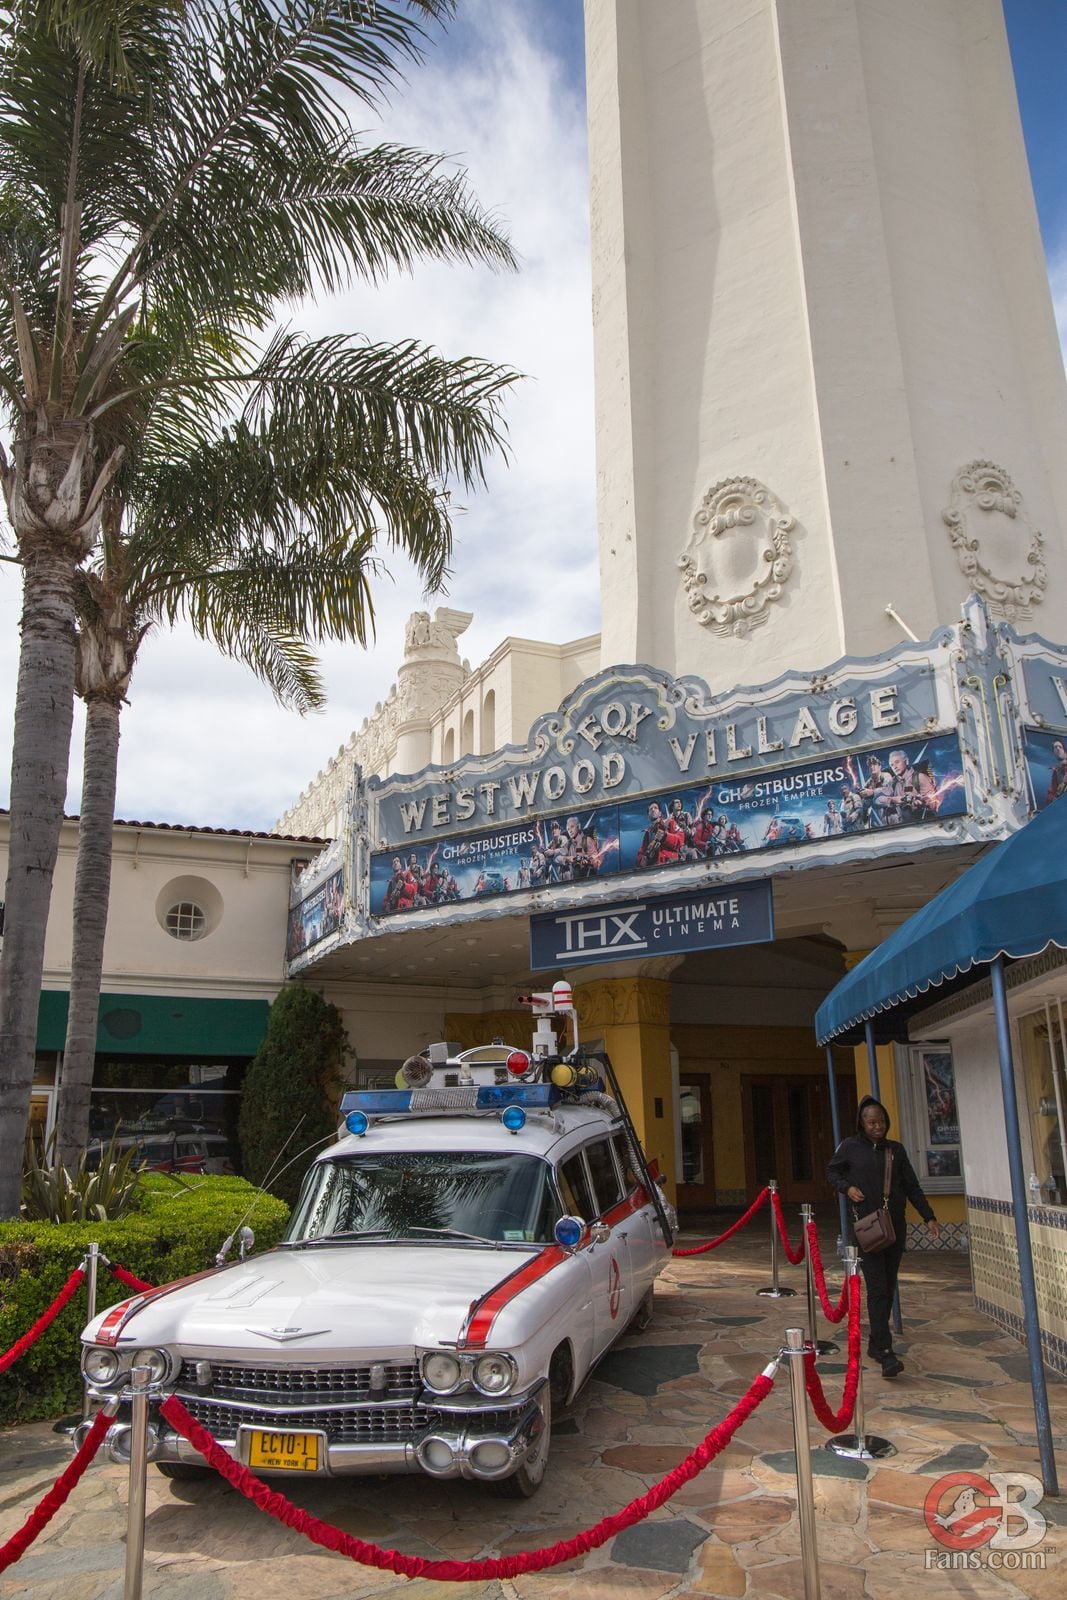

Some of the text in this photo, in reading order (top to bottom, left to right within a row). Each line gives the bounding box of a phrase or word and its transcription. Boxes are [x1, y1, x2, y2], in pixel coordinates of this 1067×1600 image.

[577, 702, 653, 751] FOX
[400, 684, 901, 833] WESTWOOD VILLAGE
[738, 787, 824, 811] FROZEN EMPIRE
[457, 847, 519, 865] FROZEN EMPIRE
[652, 898, 739, 925] ULTIMATE
[555, 905, 647, 960] THX
[653, 917, 740, 939] CINEMA
[267, 1458, 299, 1467] NEW YORK
